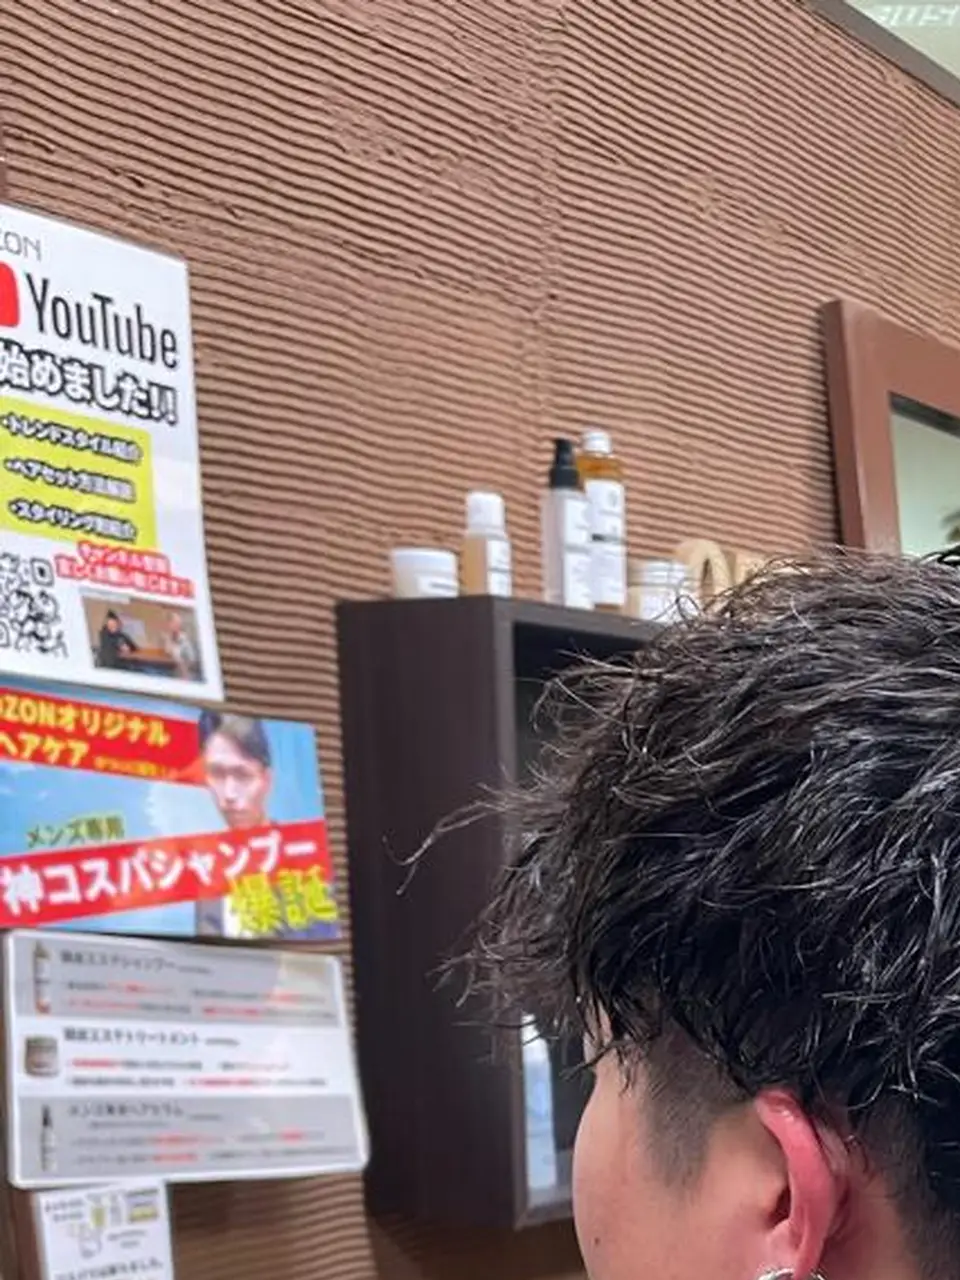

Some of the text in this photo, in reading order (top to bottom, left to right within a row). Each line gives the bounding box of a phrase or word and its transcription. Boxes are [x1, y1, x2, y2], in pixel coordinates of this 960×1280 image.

[26, 271, 178, 369] YouTube
[0, 693, 171, 749] ZONオリジナル
[1, 830, 318, 917] 神コスパシャンプー
